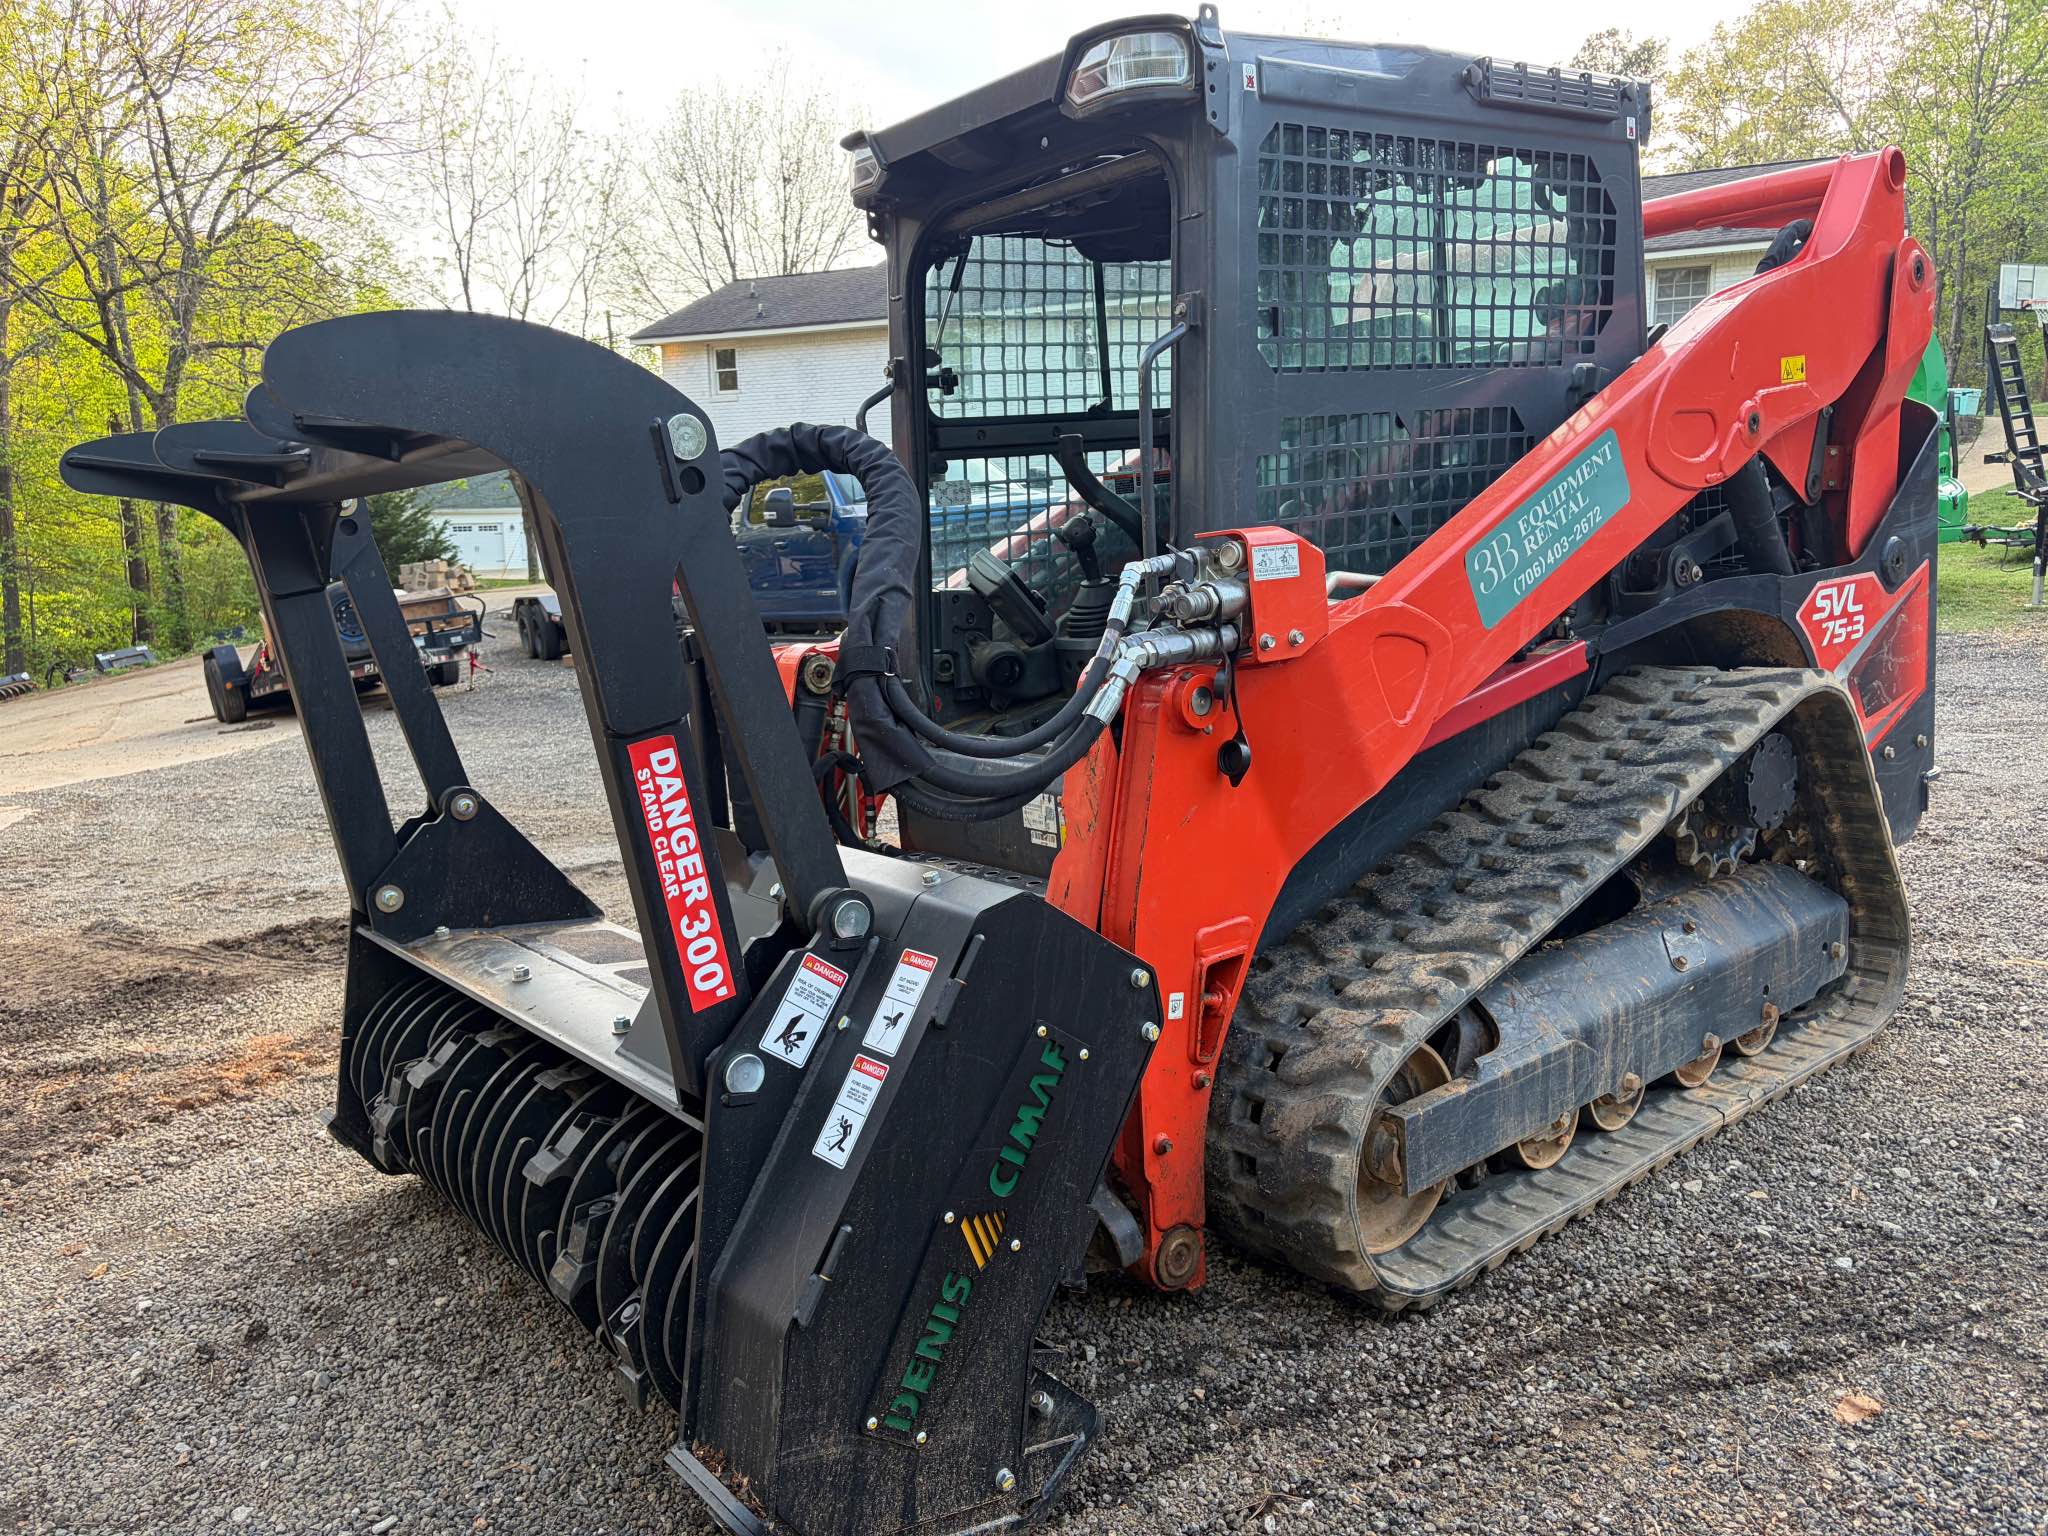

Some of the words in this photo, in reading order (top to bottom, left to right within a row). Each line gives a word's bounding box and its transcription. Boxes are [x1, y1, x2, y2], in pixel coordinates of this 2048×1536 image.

[1517, 441, 1613, 537] EQUIPMENT
[1523, 491, 1590, 557] RENTAL
[1474, 532, 1519, 595] 3B
[1812, 583, 1864, 621] SVL
[1821, 614, 1866, 647] 75-3
[637, 767, 663, 833] STAND
[653, 836, 680, 901] CLEAR
[649, 747, 709, 908] DANGER
[813, 962, 843, 984] DANGER
[909, 955, 934, 969] DANGER
[861, 1061, 885, 1078] DANGER
[989, 1040, 1068, 1198] CIMAF
[884, 1271, 973, 1431] DENIS
